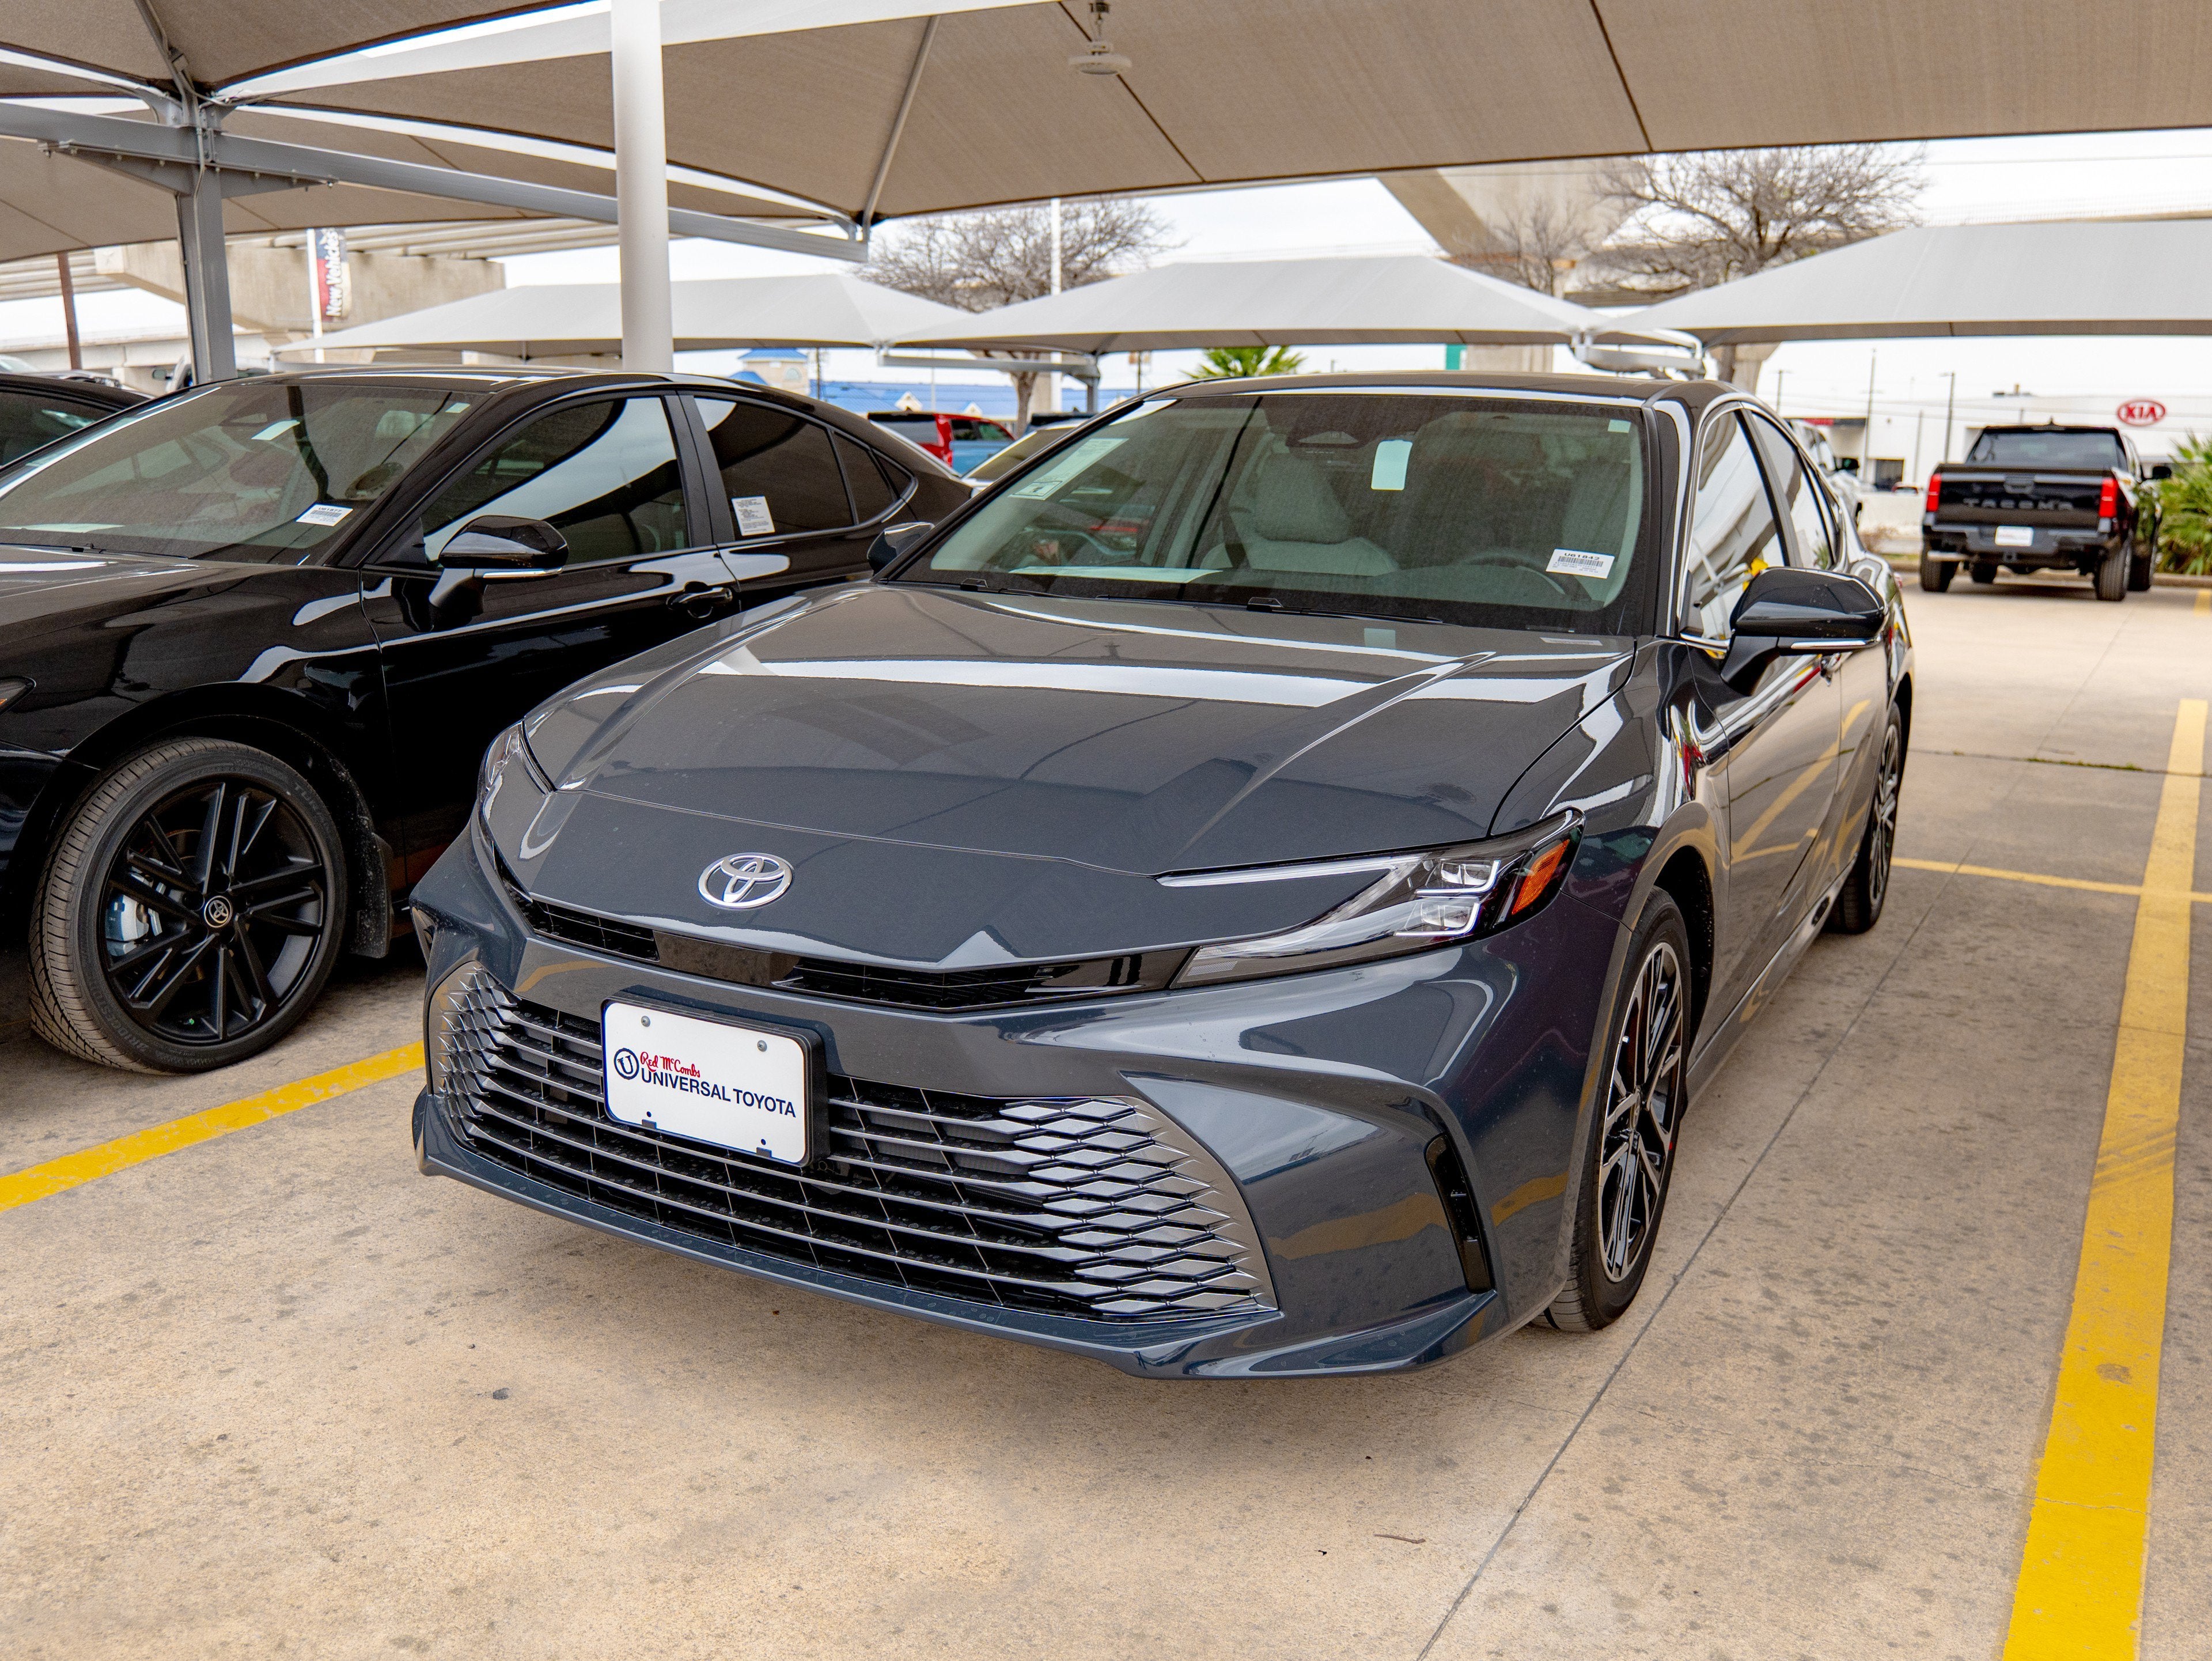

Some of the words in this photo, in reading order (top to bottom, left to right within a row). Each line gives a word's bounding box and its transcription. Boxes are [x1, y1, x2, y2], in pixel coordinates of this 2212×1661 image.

[324, 231, 342, 285] Vehicles
[326, 286, 343, 316] New
[2126, 406, 2157, 421] KIA
[85, 973, 149, 1051] BRIDGESTO
[641, 1051, 659, 1072] Red
[660, 1055, 700, 1077] McCombs
[641, 1068, 731, 1102] UNIVERSAL
[733, 1088, 797, 1118] TOYOTA
